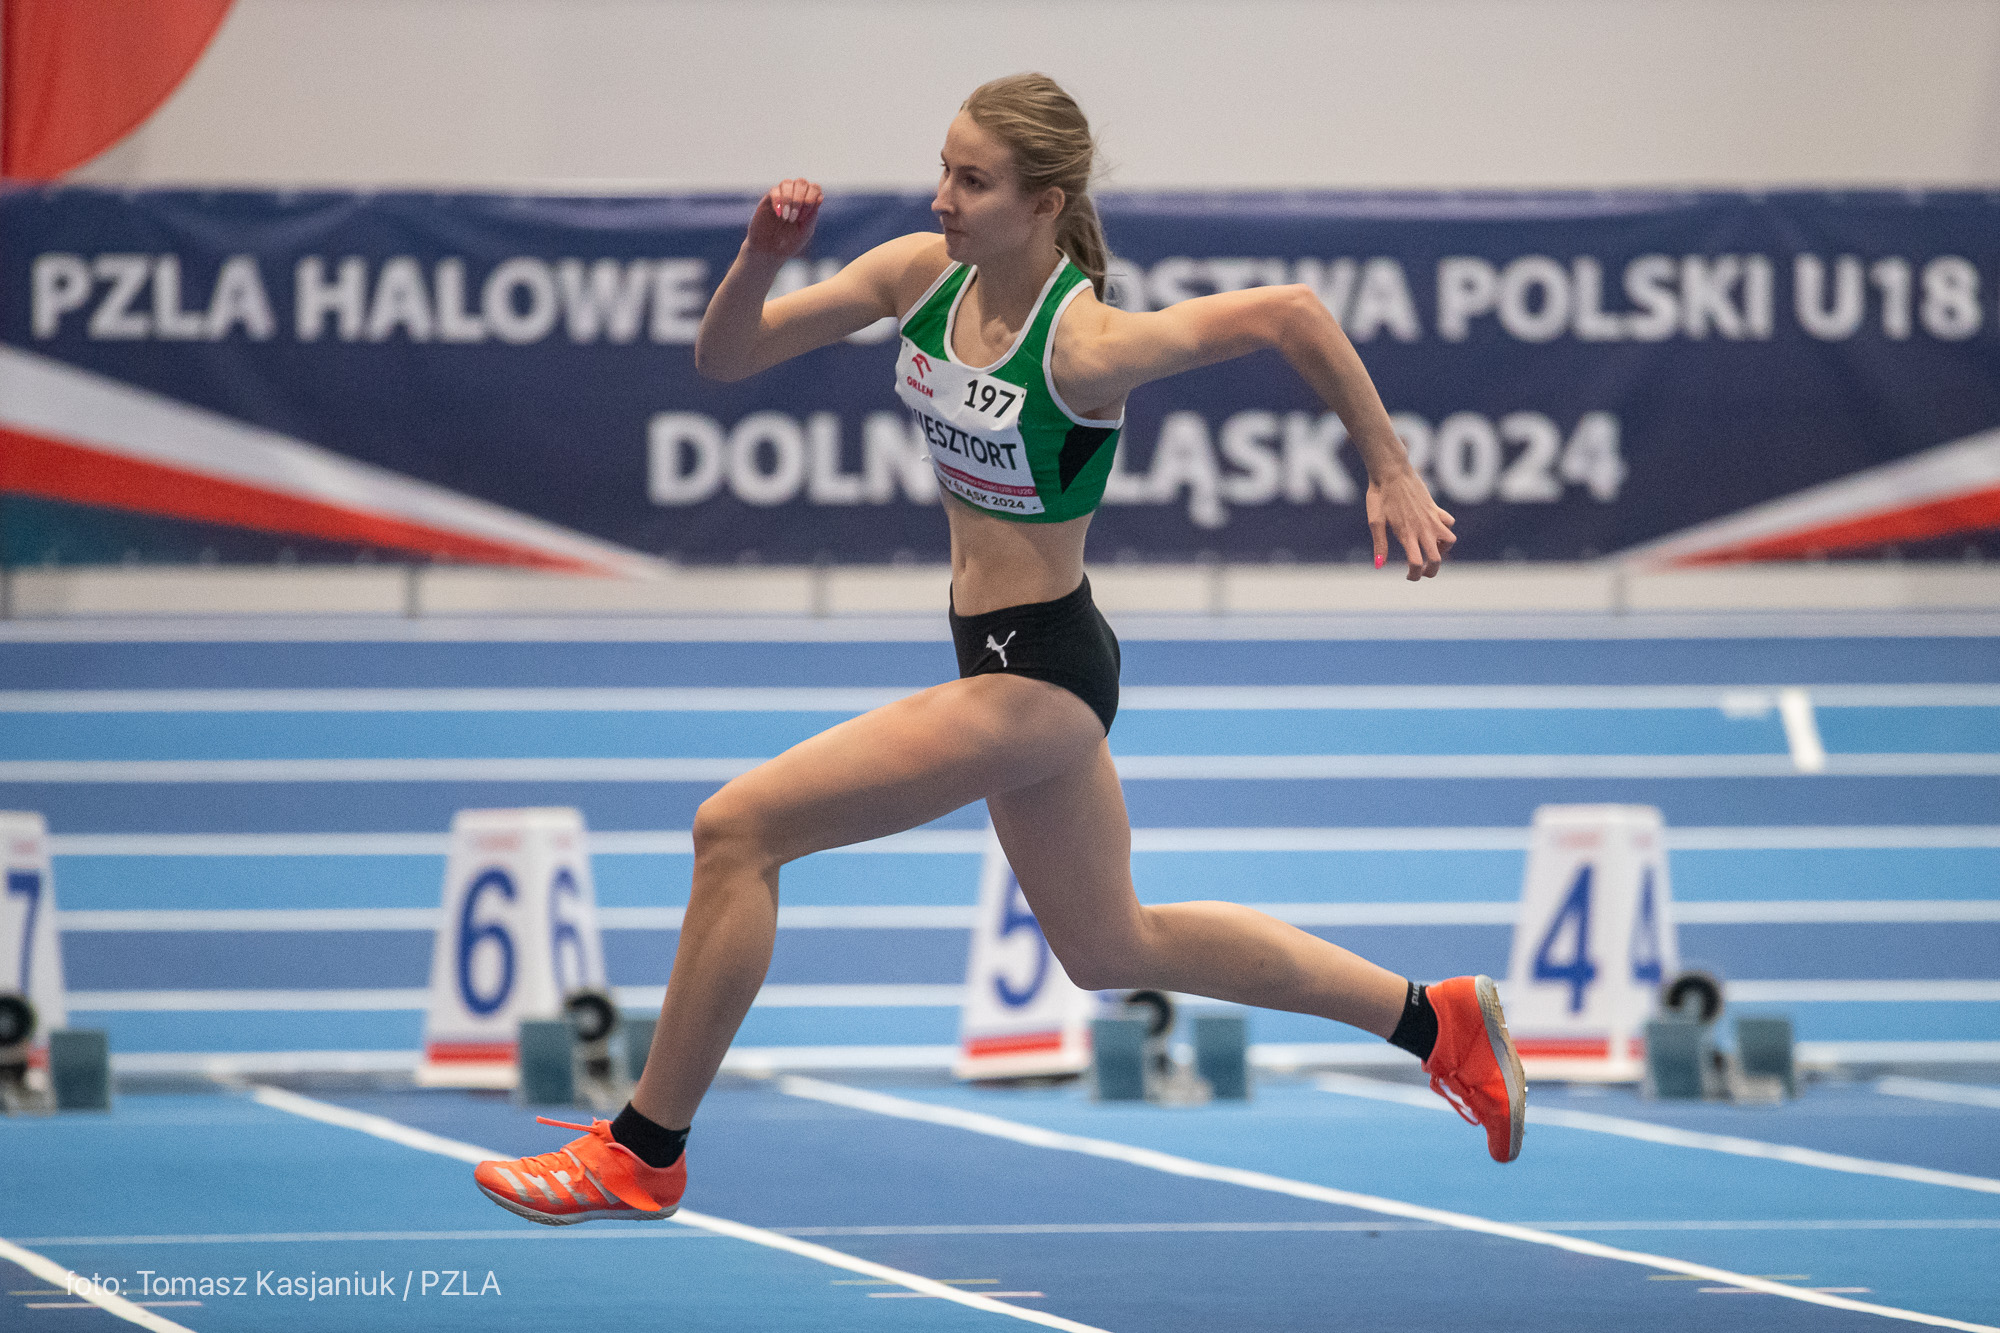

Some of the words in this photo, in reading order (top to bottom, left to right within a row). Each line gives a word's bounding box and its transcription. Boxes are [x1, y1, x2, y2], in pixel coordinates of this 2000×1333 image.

[32, 254, 274, 340] PZLA
[297, 256, 708, 344] HALOWE
[1436, 254, 1773, 342] POLSKI
[1794, 254, 1982, 341] U18
[906, 375, 934, 398] ORLEN
[964, 379, 1017, 419] 197
[647, 410, 940, 505] DOLN
[913, 408, 1017, 471] IESZTORT
[991, 496, 1025, 510] 2024
[6, 868, 43, 996] 7
[455, 867, 517, 1017] 6
[1531, 864, 1597, 1013] 4
